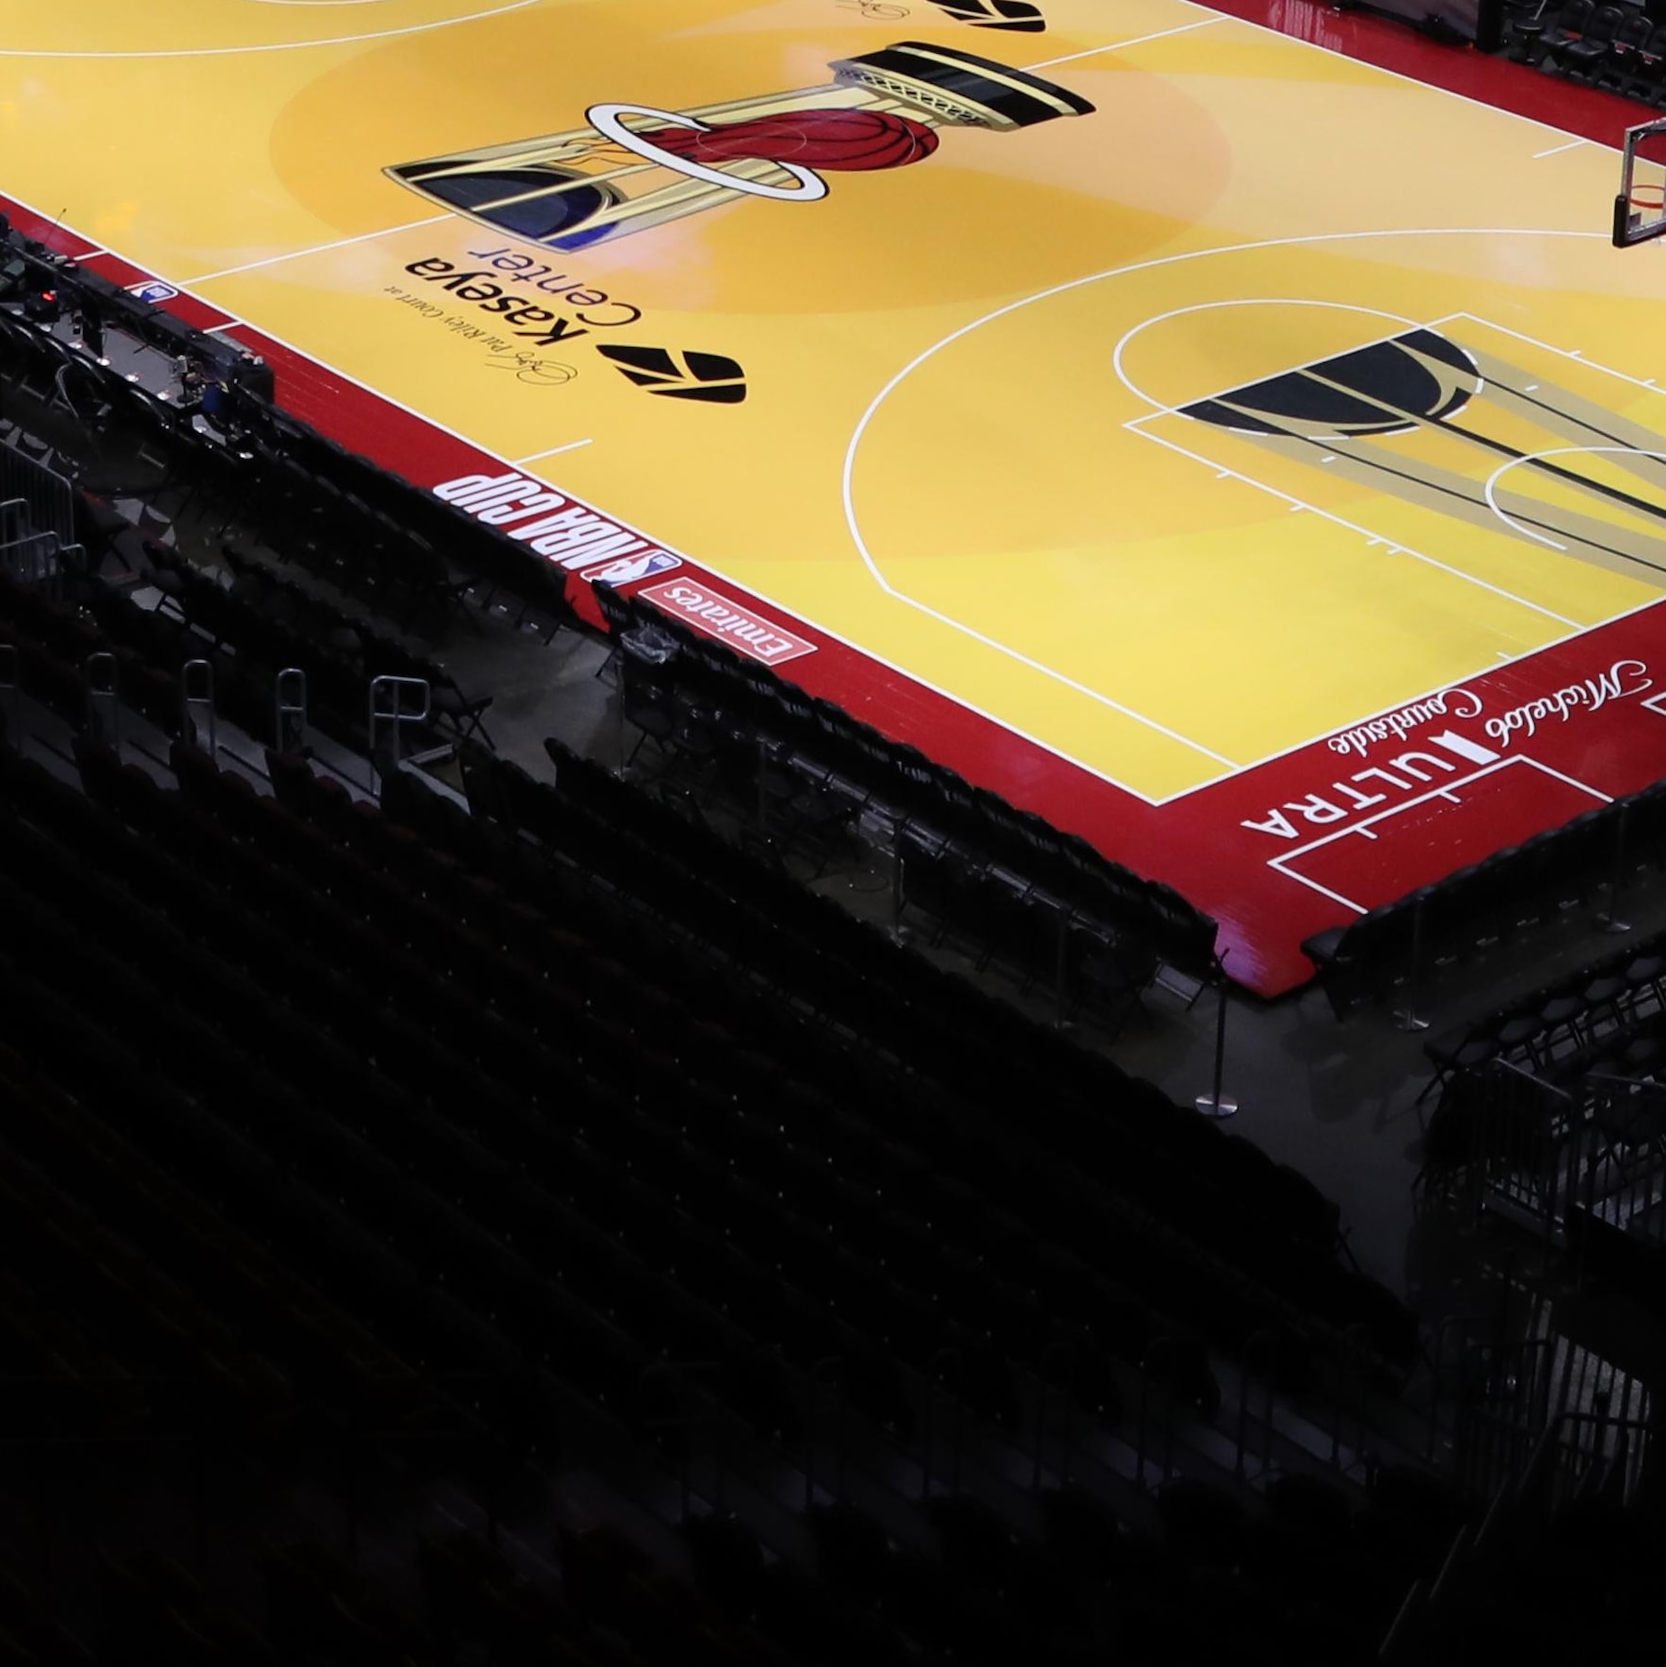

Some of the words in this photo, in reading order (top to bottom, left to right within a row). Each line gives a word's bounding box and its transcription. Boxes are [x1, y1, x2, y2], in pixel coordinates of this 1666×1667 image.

[404, 257, 590, 347] Kaseya
[468, 248, 642, 327] Center
[433, 472, 565, 525] CUP
[506, 506, 649, 571] NBA
[663, 585, 794, 658] Emirates
[1328, 687, 1483, 757] Courtside
[1485, 659, 1653, 748] Michelob
[1240, 750, 1456, 838] ULTRA
